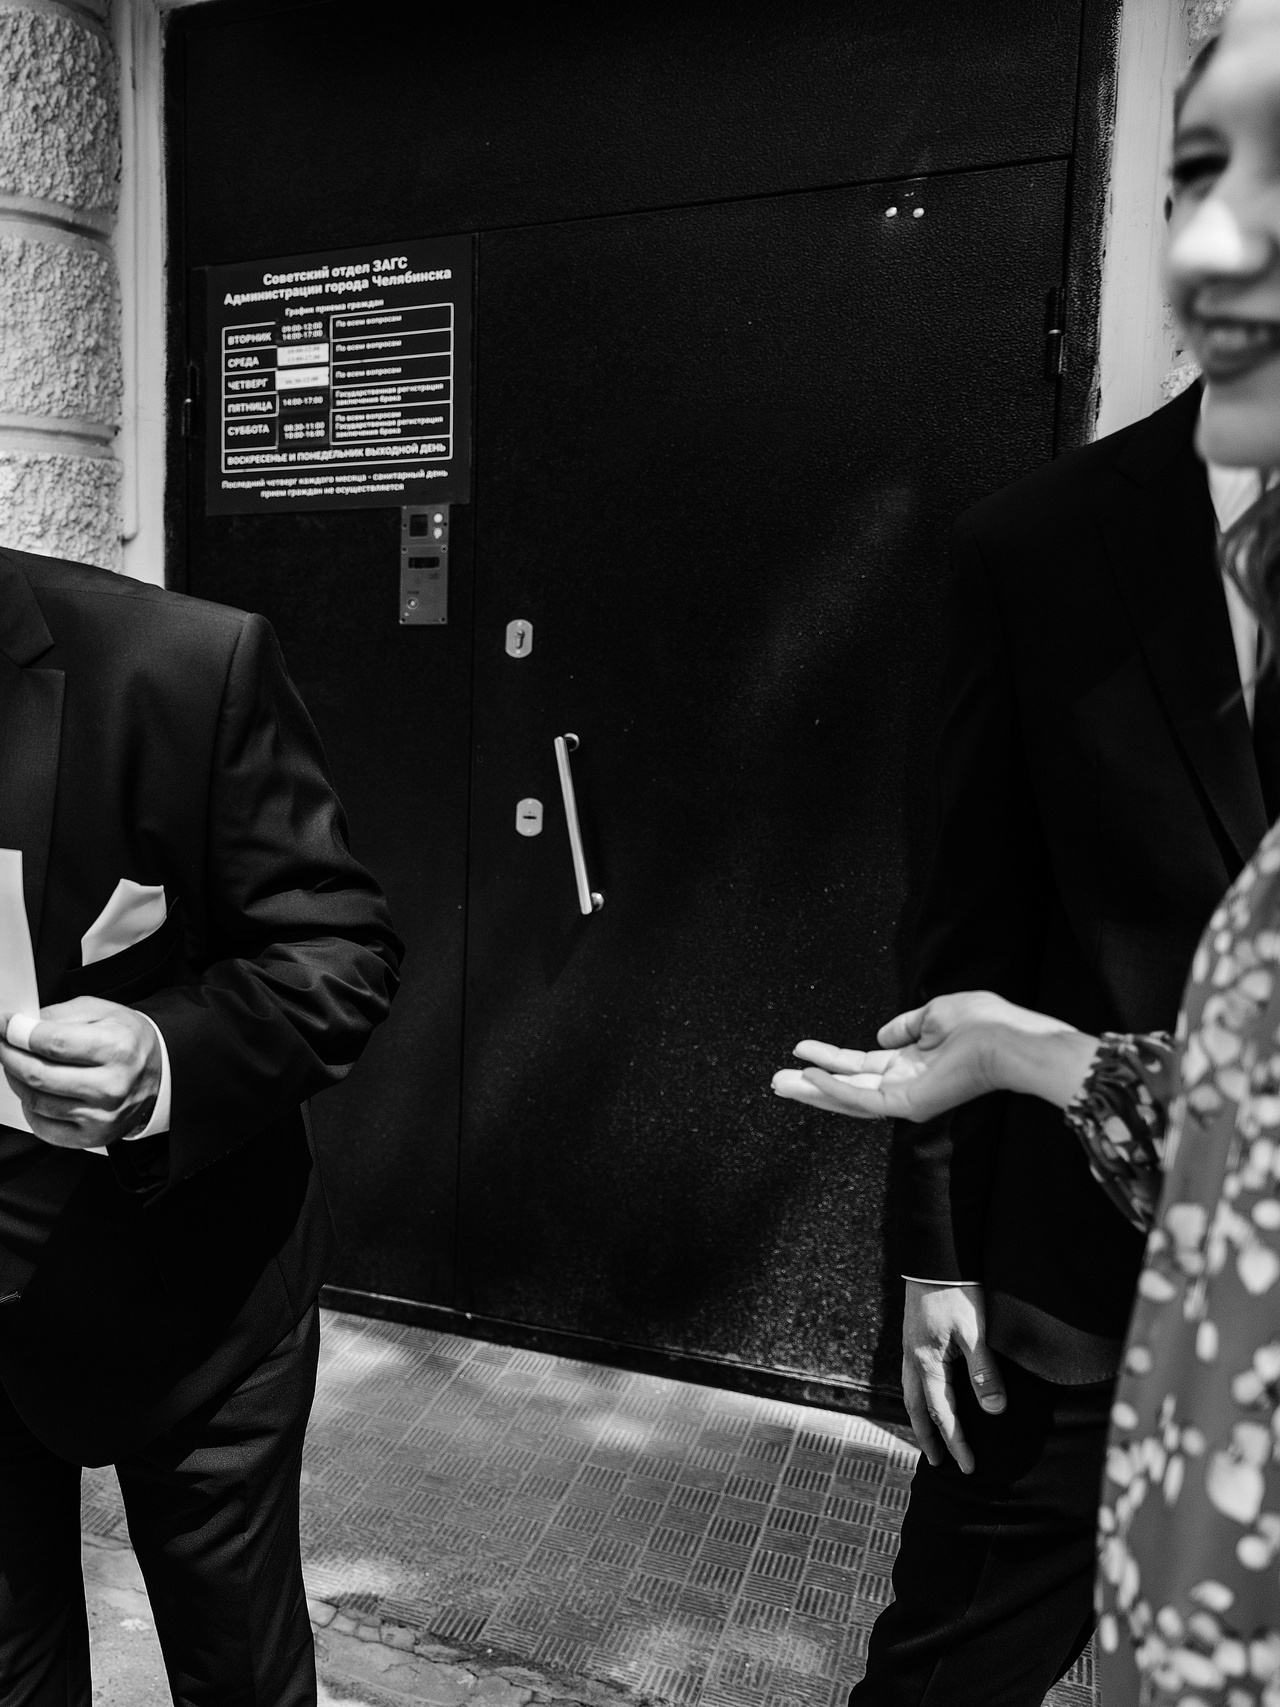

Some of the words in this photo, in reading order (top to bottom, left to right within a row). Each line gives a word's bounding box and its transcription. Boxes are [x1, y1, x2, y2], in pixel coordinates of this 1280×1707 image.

[263, 266, 329, 286] Советский
[331, 263, 370, 278] отдел
[372, 256, 408, 273] ЗАГС
[224, 282, 322, 306] Администрации
[324, 278, 369, 295] города
[371, 269, 452, 287] Челябинска
[284, 306, 314, 318] График
[227, 332, 272, 346] ВТОРНИК
[227, 356, 260, 368] СРЕДА
[227, 377, 269, 390] ЧЕТВЕРГ
[227, 401, 273, 414] ПЯТНИЦА
[227, 424, 270, 436] СУББОТА
[227, 453, 288, 466] ВОСКРЕСЕНЬЕ
[288, 453, 297, 462] И
[297, 448, 364, 462] ПОНЕДЕЛЬНИК
[365, 442, 419, 457] ВЫХОДНОЙ
[419, 443, 447, 455] ДЕНЬ
[221, 478, 266, 490] Последний
[266, 478, 298, 488] четверг
[298, 476, 334, 486] каждого
[335, 474, 367, 483] месяца
[372, 469, 425, 481] санитарный
[426, 470, 449, 480] день
[287, 487, 323, 498] граждан
[323, 487, 335, 495] не
[335, 483, 405, 496] осуществляется
